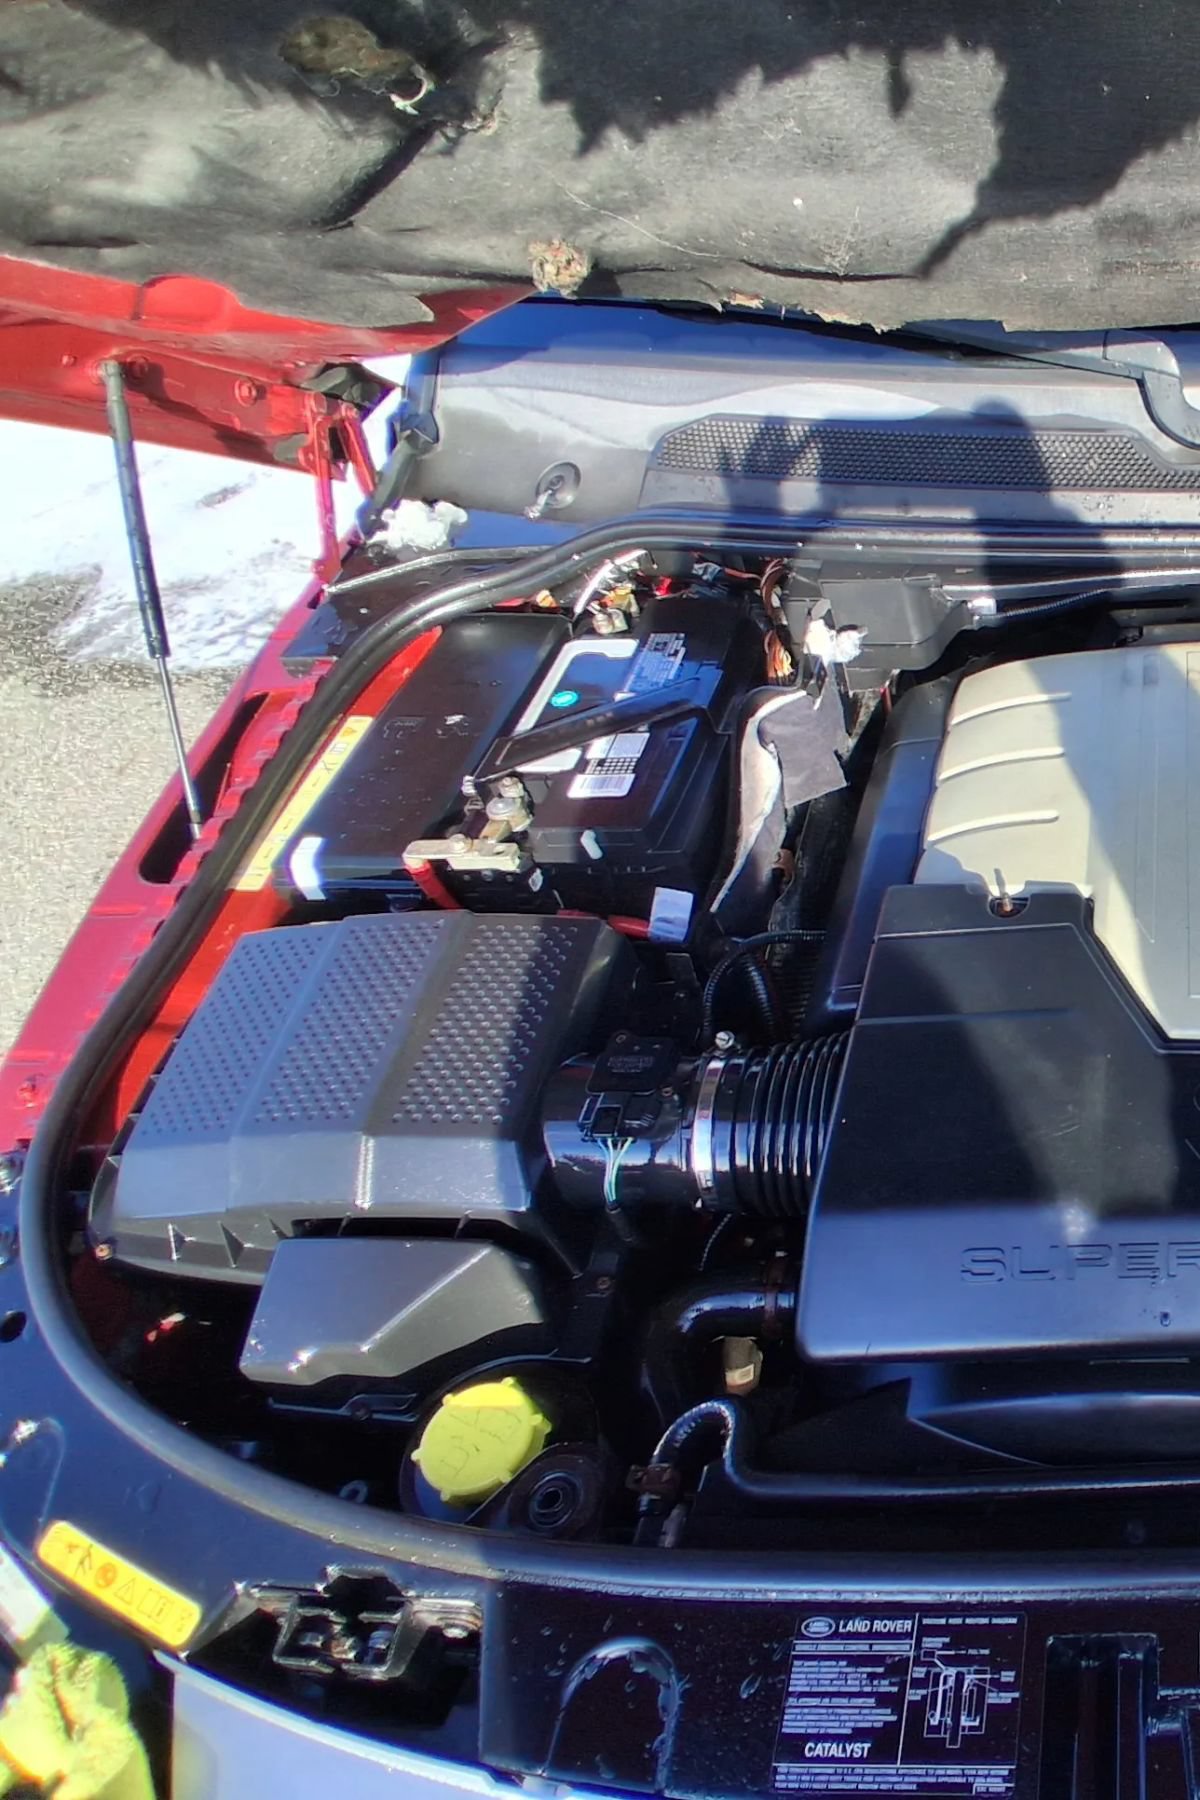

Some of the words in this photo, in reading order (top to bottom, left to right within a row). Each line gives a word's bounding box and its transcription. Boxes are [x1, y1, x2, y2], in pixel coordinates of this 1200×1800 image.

[838, 1620, 871, 1632] LAND
[873, 1619, 913, 1633] ROVER
[804, 1742, 872, 1758] CATALYST
